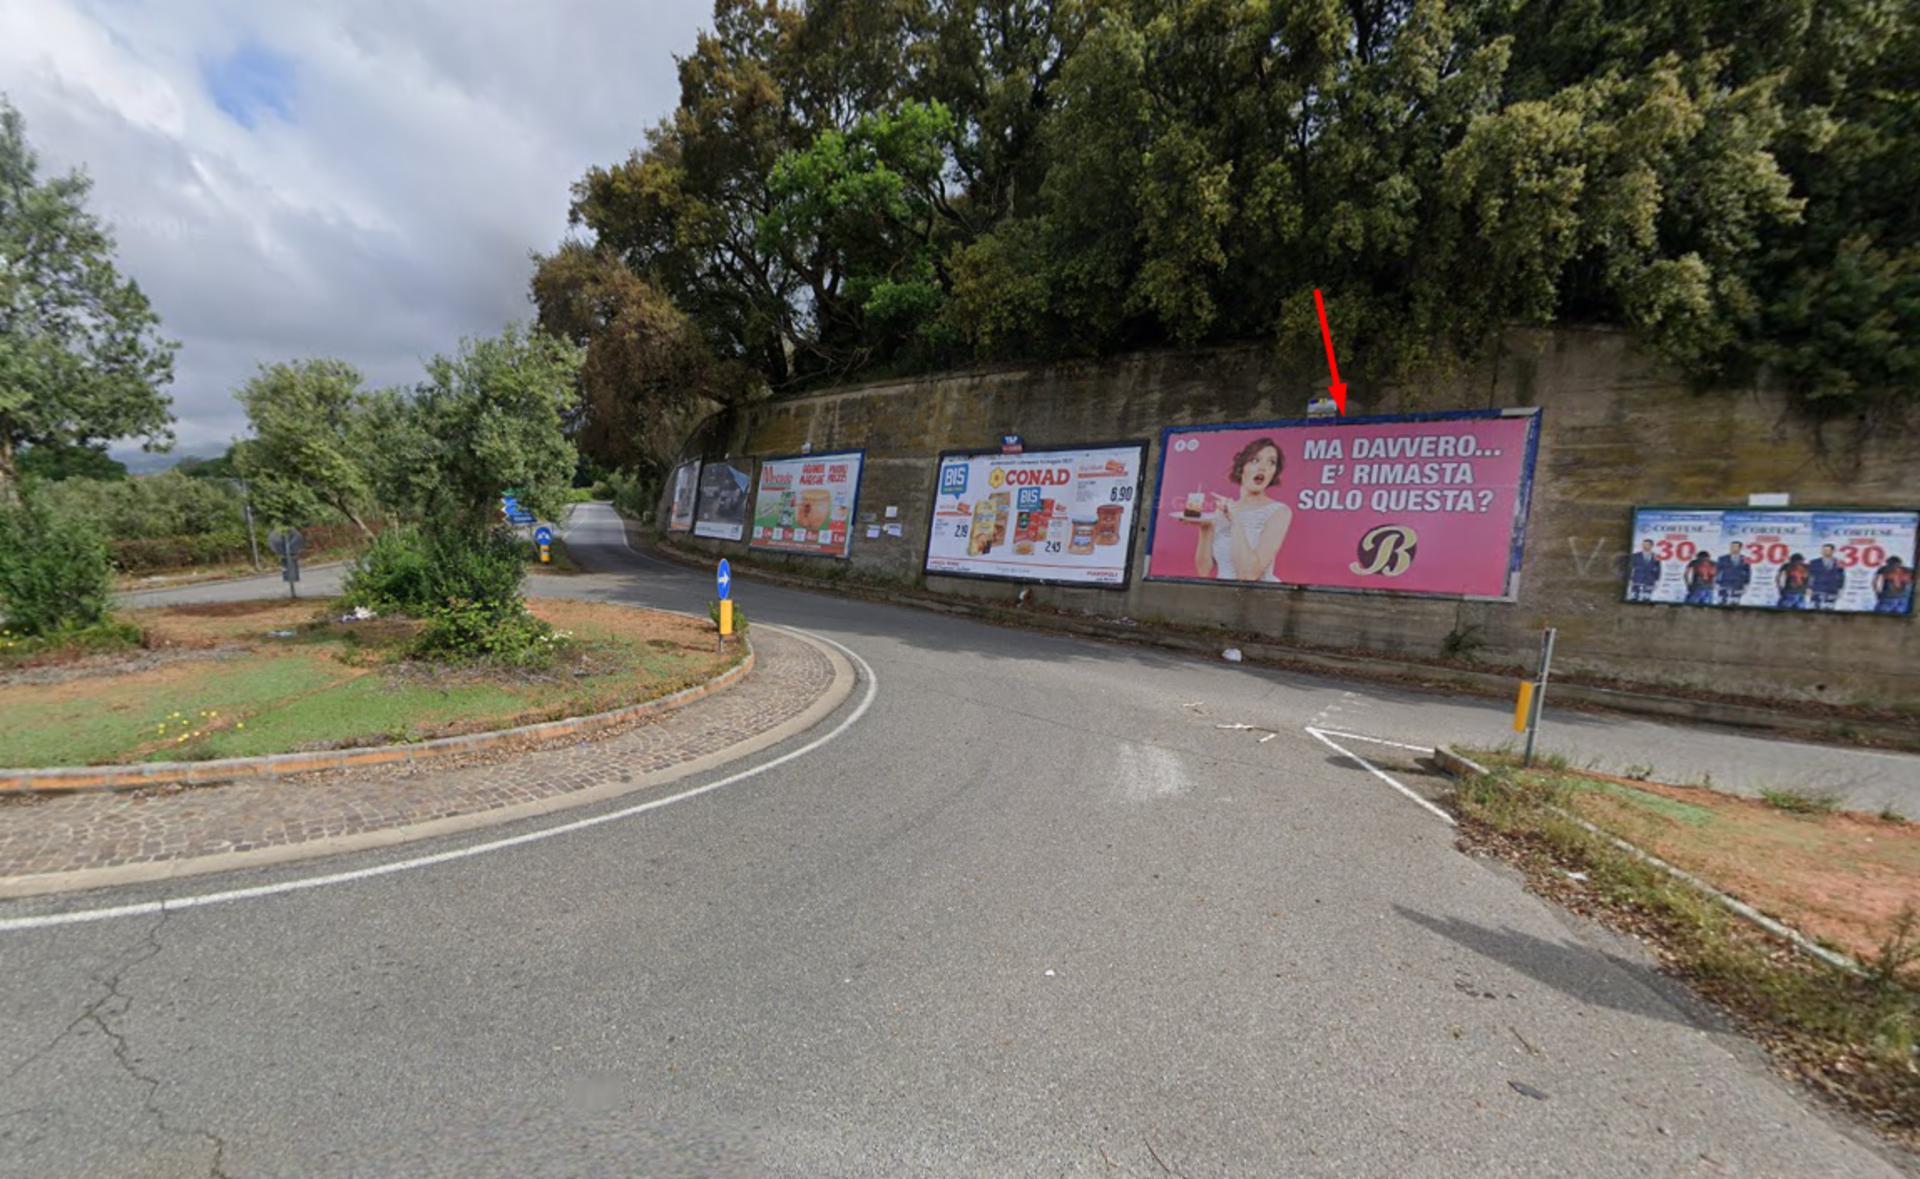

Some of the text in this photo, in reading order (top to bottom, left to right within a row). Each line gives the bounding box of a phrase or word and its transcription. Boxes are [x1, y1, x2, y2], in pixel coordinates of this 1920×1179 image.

[1303, 434, 1502, 460] MA DAVVERO...
[944, 466, 967, 487] BIS
[1005, 467, 1071, 487] CONAD
[1351, 462, 1474, 485] RIMASTA
[1020, 489, 1039, 504] BIS
[1297, 489, 1495, 513] SOLO QUESTA?
[1654, 539, 1697, 562] 30
[1743, 542, 1790, 565] 30
[1836, 545, 1886, 568] 30
